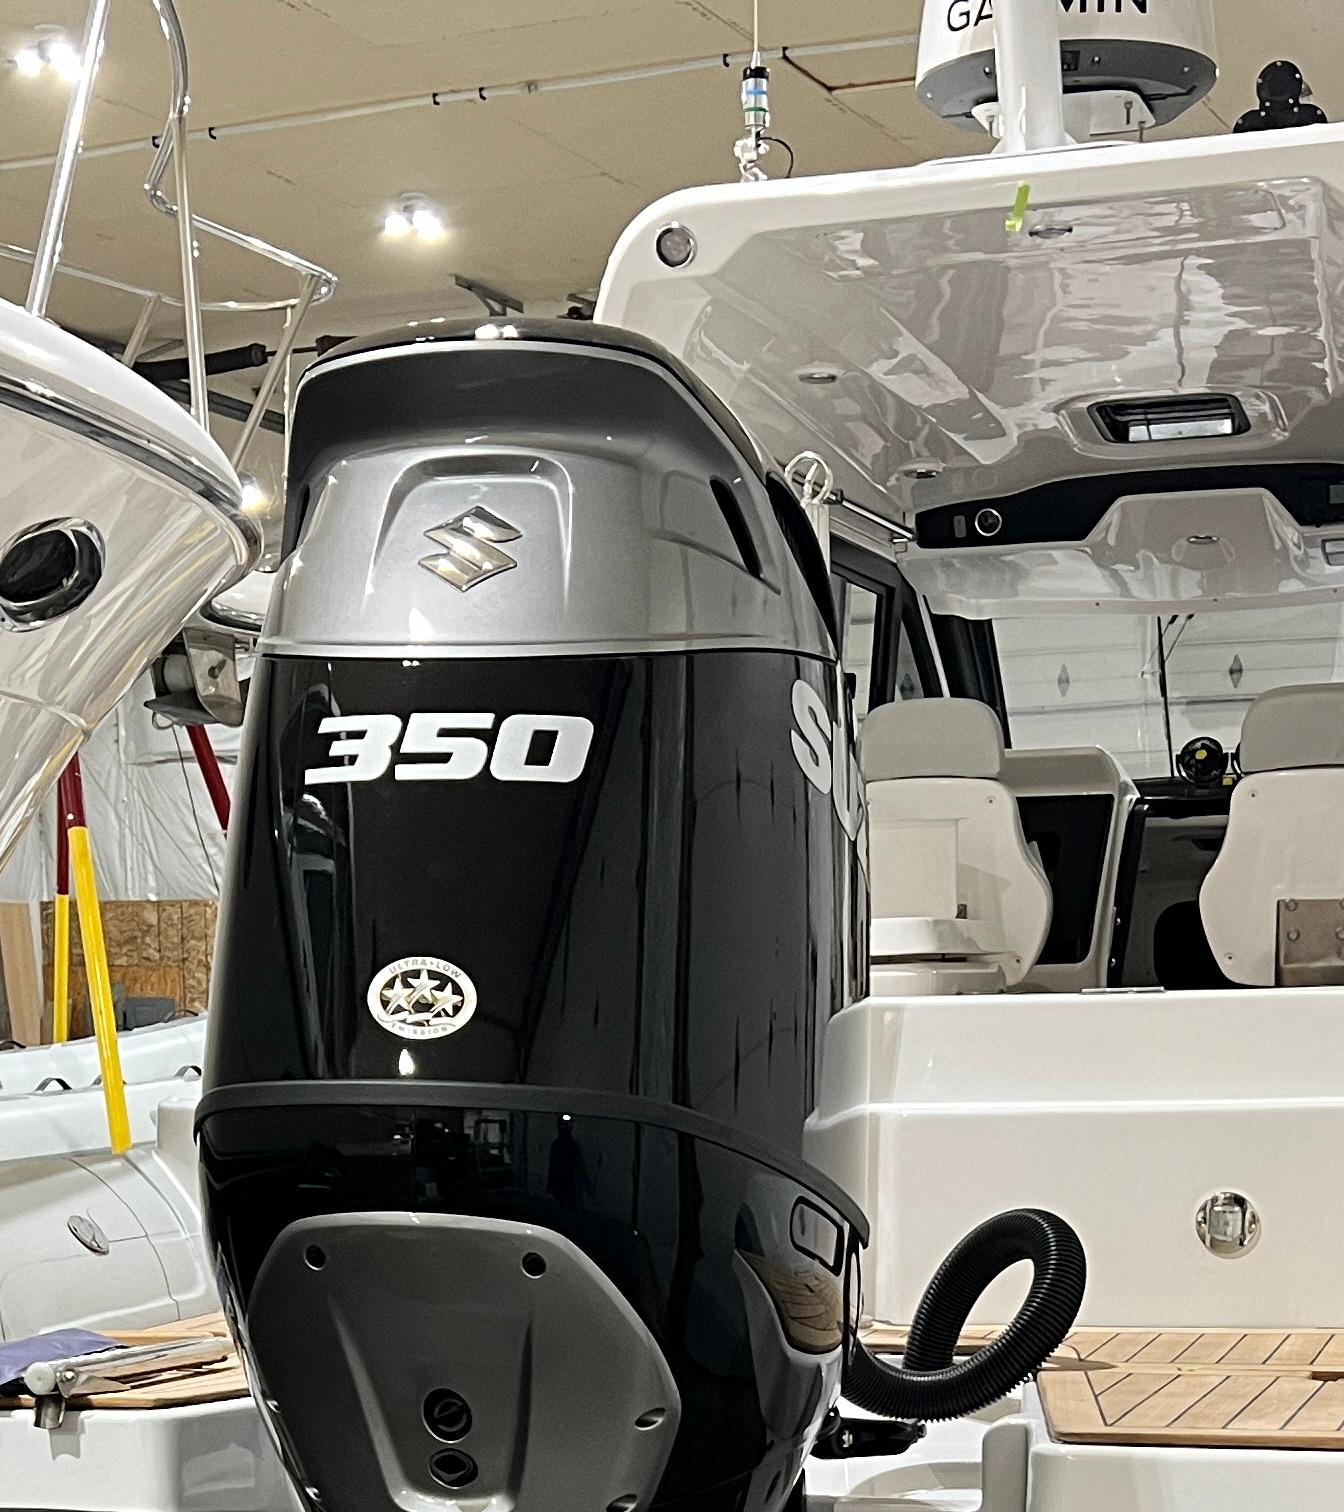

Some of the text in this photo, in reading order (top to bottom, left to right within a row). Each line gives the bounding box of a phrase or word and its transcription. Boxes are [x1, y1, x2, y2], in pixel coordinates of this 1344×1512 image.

[305, 712, 594, 784] 350
[790, 679, 868, 858] SU
[389, 959, 427, 973] ULTRA
